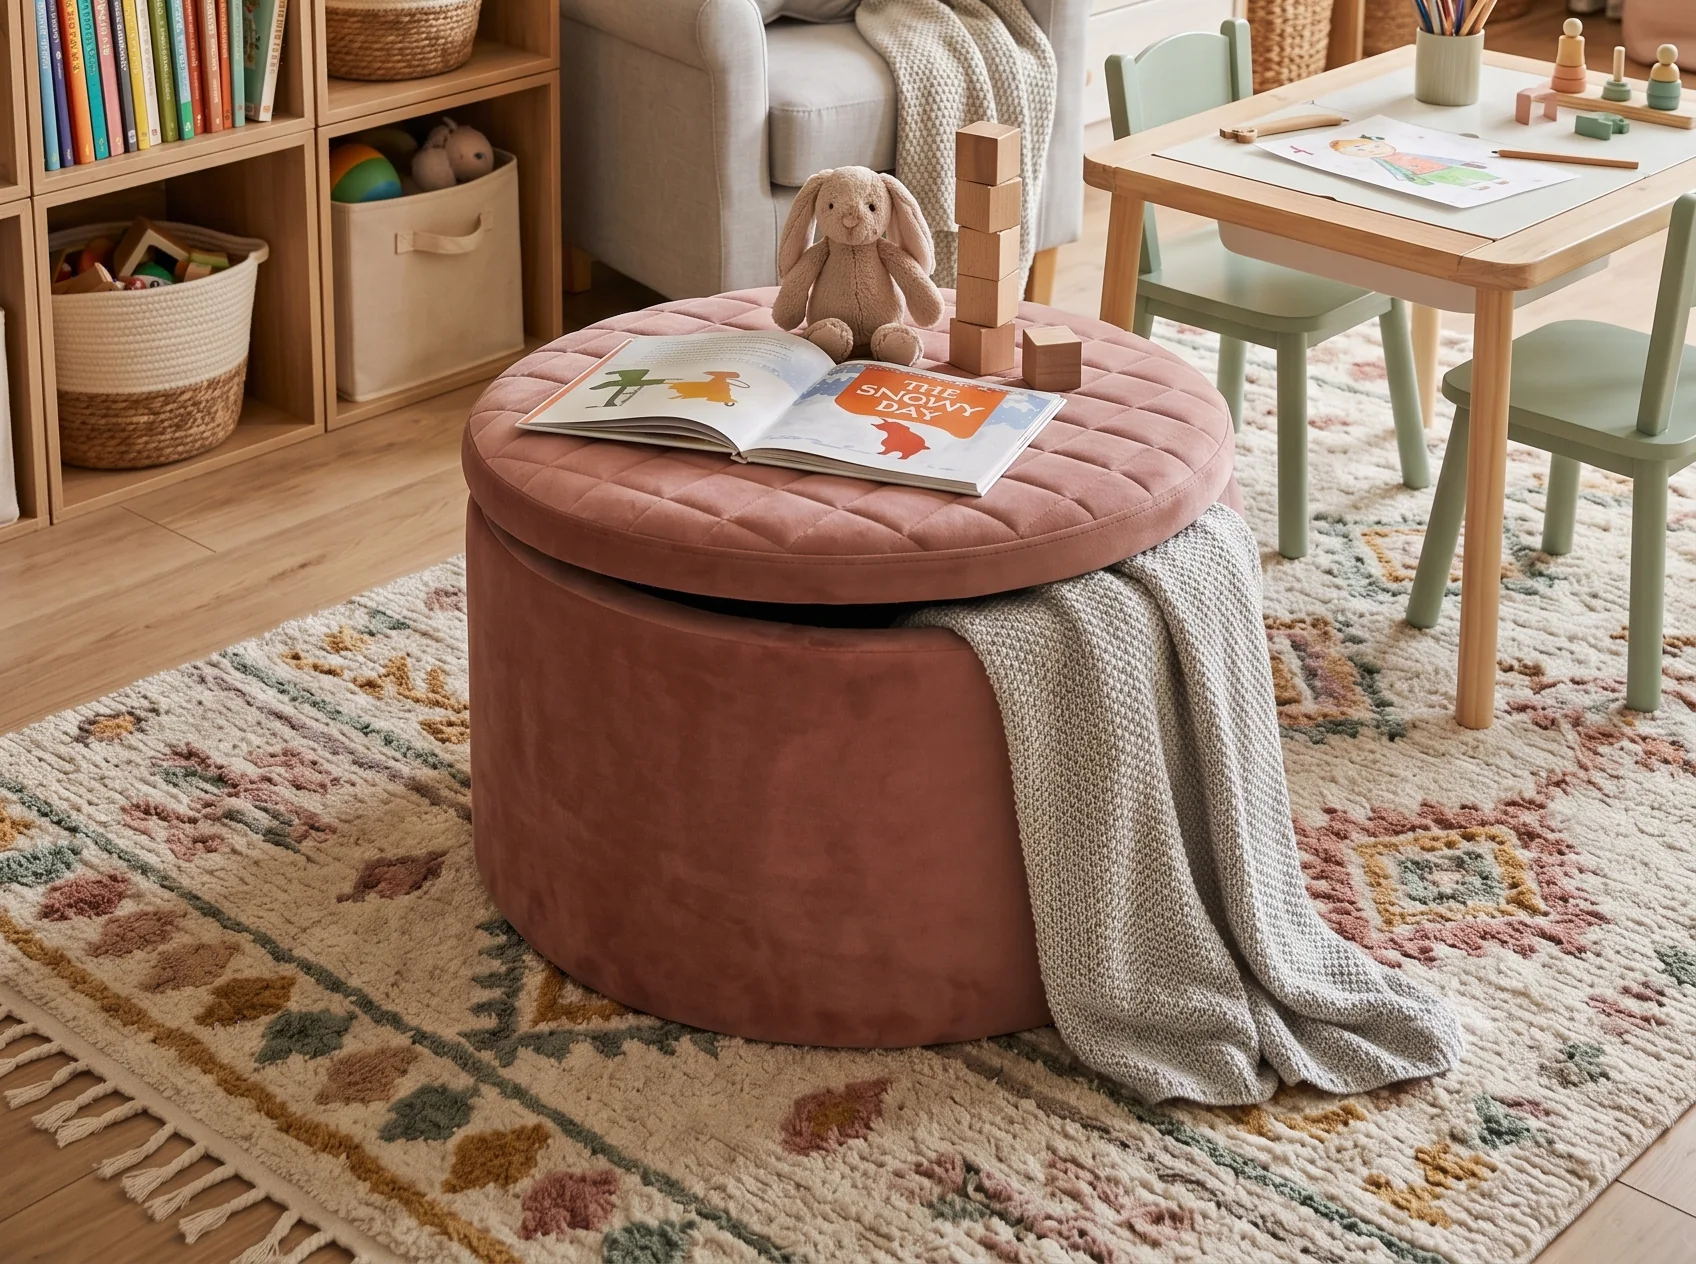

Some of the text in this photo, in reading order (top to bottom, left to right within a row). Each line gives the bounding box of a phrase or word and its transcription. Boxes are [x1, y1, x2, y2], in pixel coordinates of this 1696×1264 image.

[904, 380, 961, 399] THE
[856, 385, 985, 417] SNOWY
[875, 400, 942, 421] DAY
